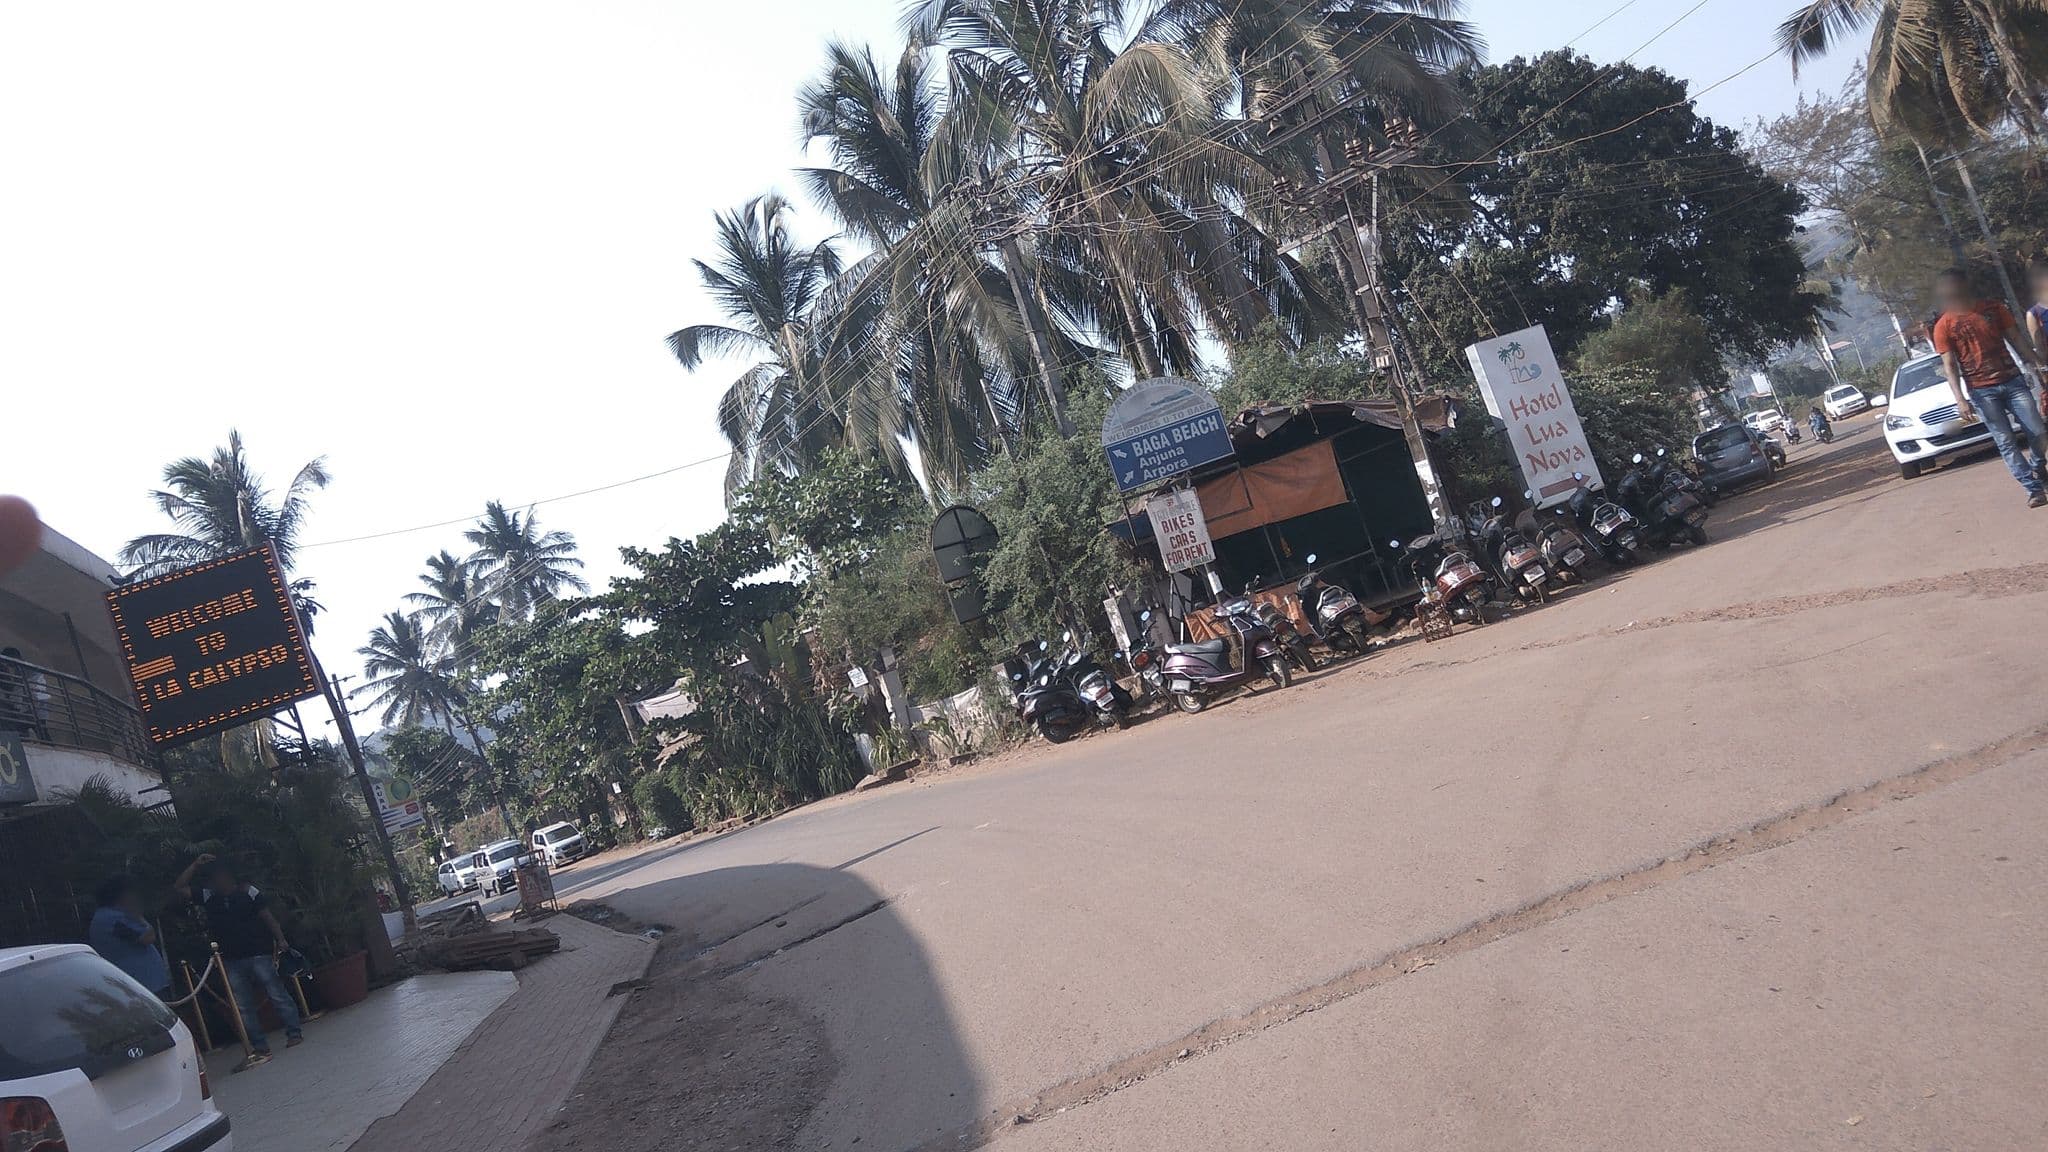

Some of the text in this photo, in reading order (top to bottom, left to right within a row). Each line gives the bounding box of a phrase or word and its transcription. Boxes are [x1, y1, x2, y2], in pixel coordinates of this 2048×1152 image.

[1509, 383, 1562, 421] Hotel
[1132, 415, 1219, 457] BAGA BEACH
[1524, 421, 1568, 446] Lua
[1139, 446, 1184, 469] Anjuna
[1143, 457, 1189, 480] Arpora
[1525, 445, 1586, 475] Nova
[1161, 513, 1195, 533] BIKES
[1169, 530, 1197, 549] CARS
[1166, 549, 1185, 566] FOR
[1184, 542, 1208, 561] RENT
[146, 588, 257, 639] WELCOME
[195, 631, 226, 656] TO
[153, 644, 289, 700] LA CALYPSO
